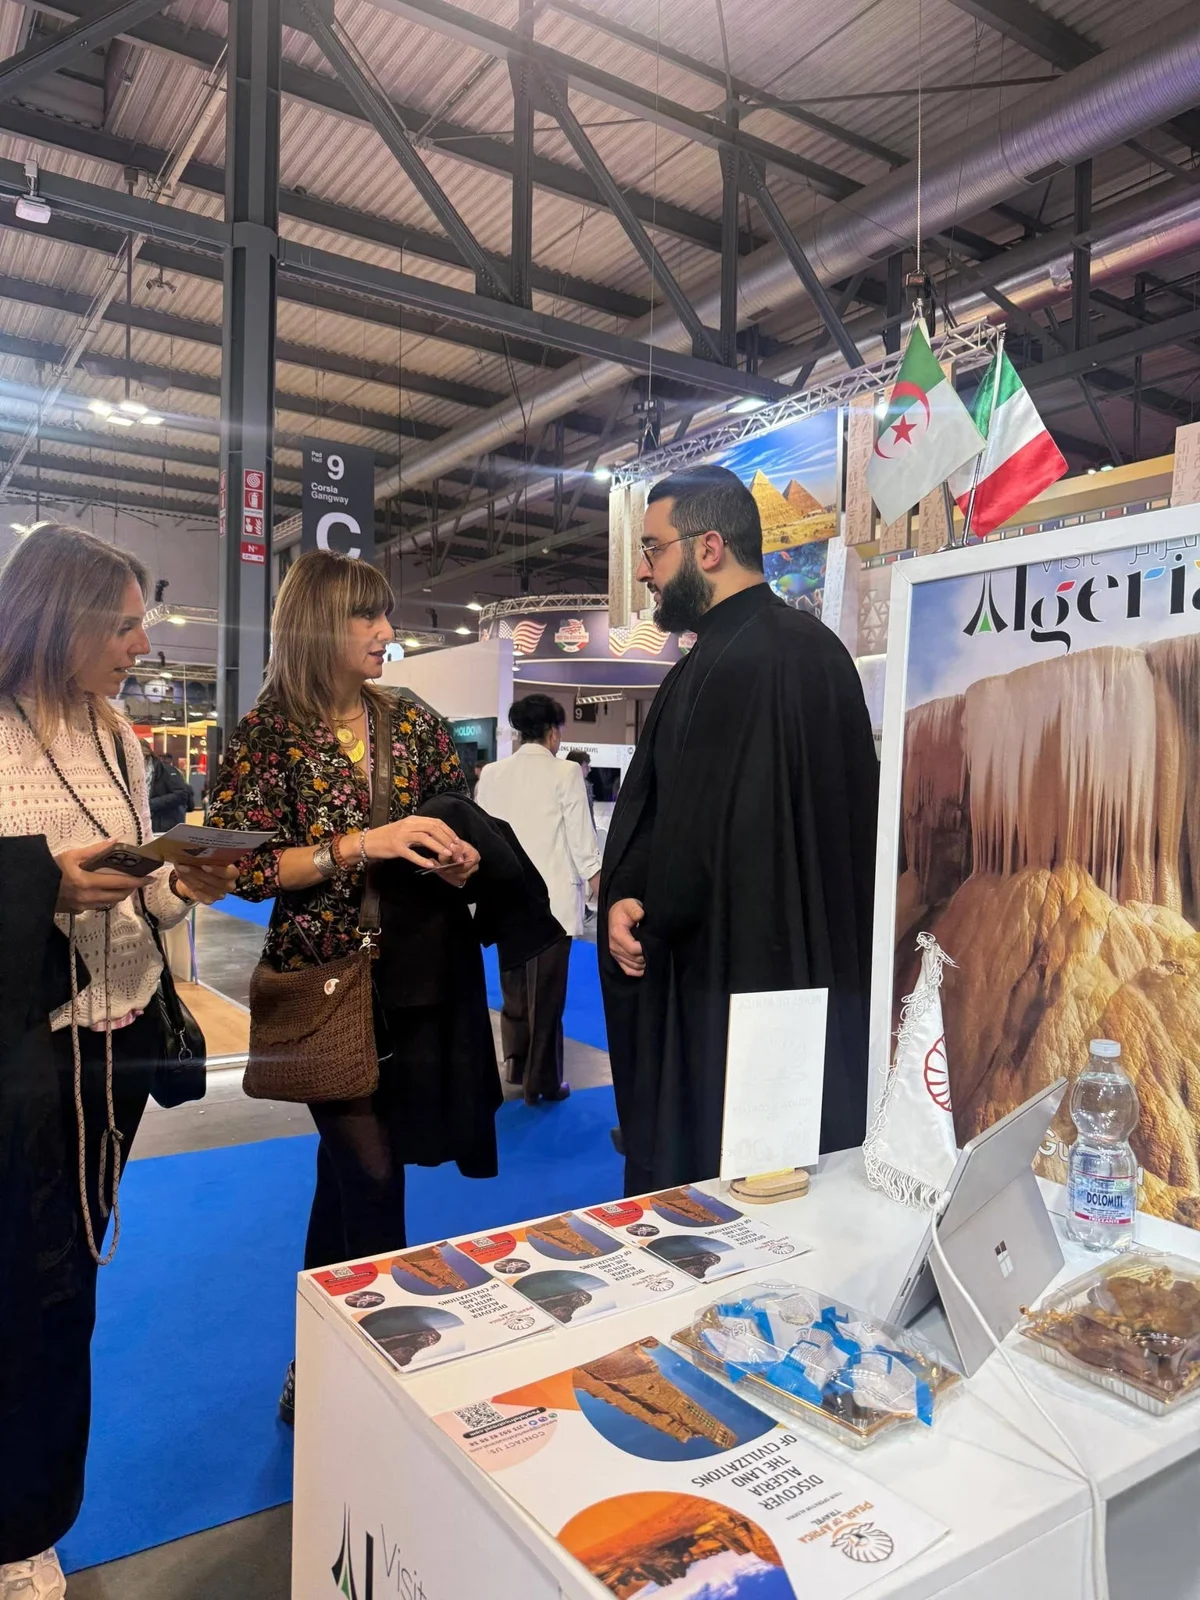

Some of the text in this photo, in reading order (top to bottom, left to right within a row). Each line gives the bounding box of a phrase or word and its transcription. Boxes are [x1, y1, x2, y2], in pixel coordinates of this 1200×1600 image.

[311, 450, 322, 458] Pad
[327, 454, 344, 480] 9
[311, 482, 338, 494] Corsia
[311, 491, 349, 505] Gangway
[316, 512, 361, 559] C
[963, 553, 1200, 654] Algeri
[575, 708, 582, 720] 9
[1086, 1192, 1124, 1208] DOLOMITI
[598, 1262, 616, 1270] LAND
[610, 1266, 636, 1277] ALGERIA
[612, 1268, 645, 1281] DISCOVER
[438, 1288, 490, 1306] CIVILIZATIONS
[458, 1296, 479, 1306] LAND
[469, 1302, 499, 1314] ALGERIA
[472, 1304, 508, 1319] DISCOVER
[505, 1431, 546, 1449] CONTACT
[691, 1434, 798, 1488] OF CIVILIZATIONS
[732, 1456, 791, 1488] THE LAND
[748, 1466, 802, 1496] ALGERIA
[758, 1474, 824, 1510] DISCOVER
[798, 1500, 874, 1544] PEARL OF AFRICA
[810, 1508, 842, 1526] TRAVEL
